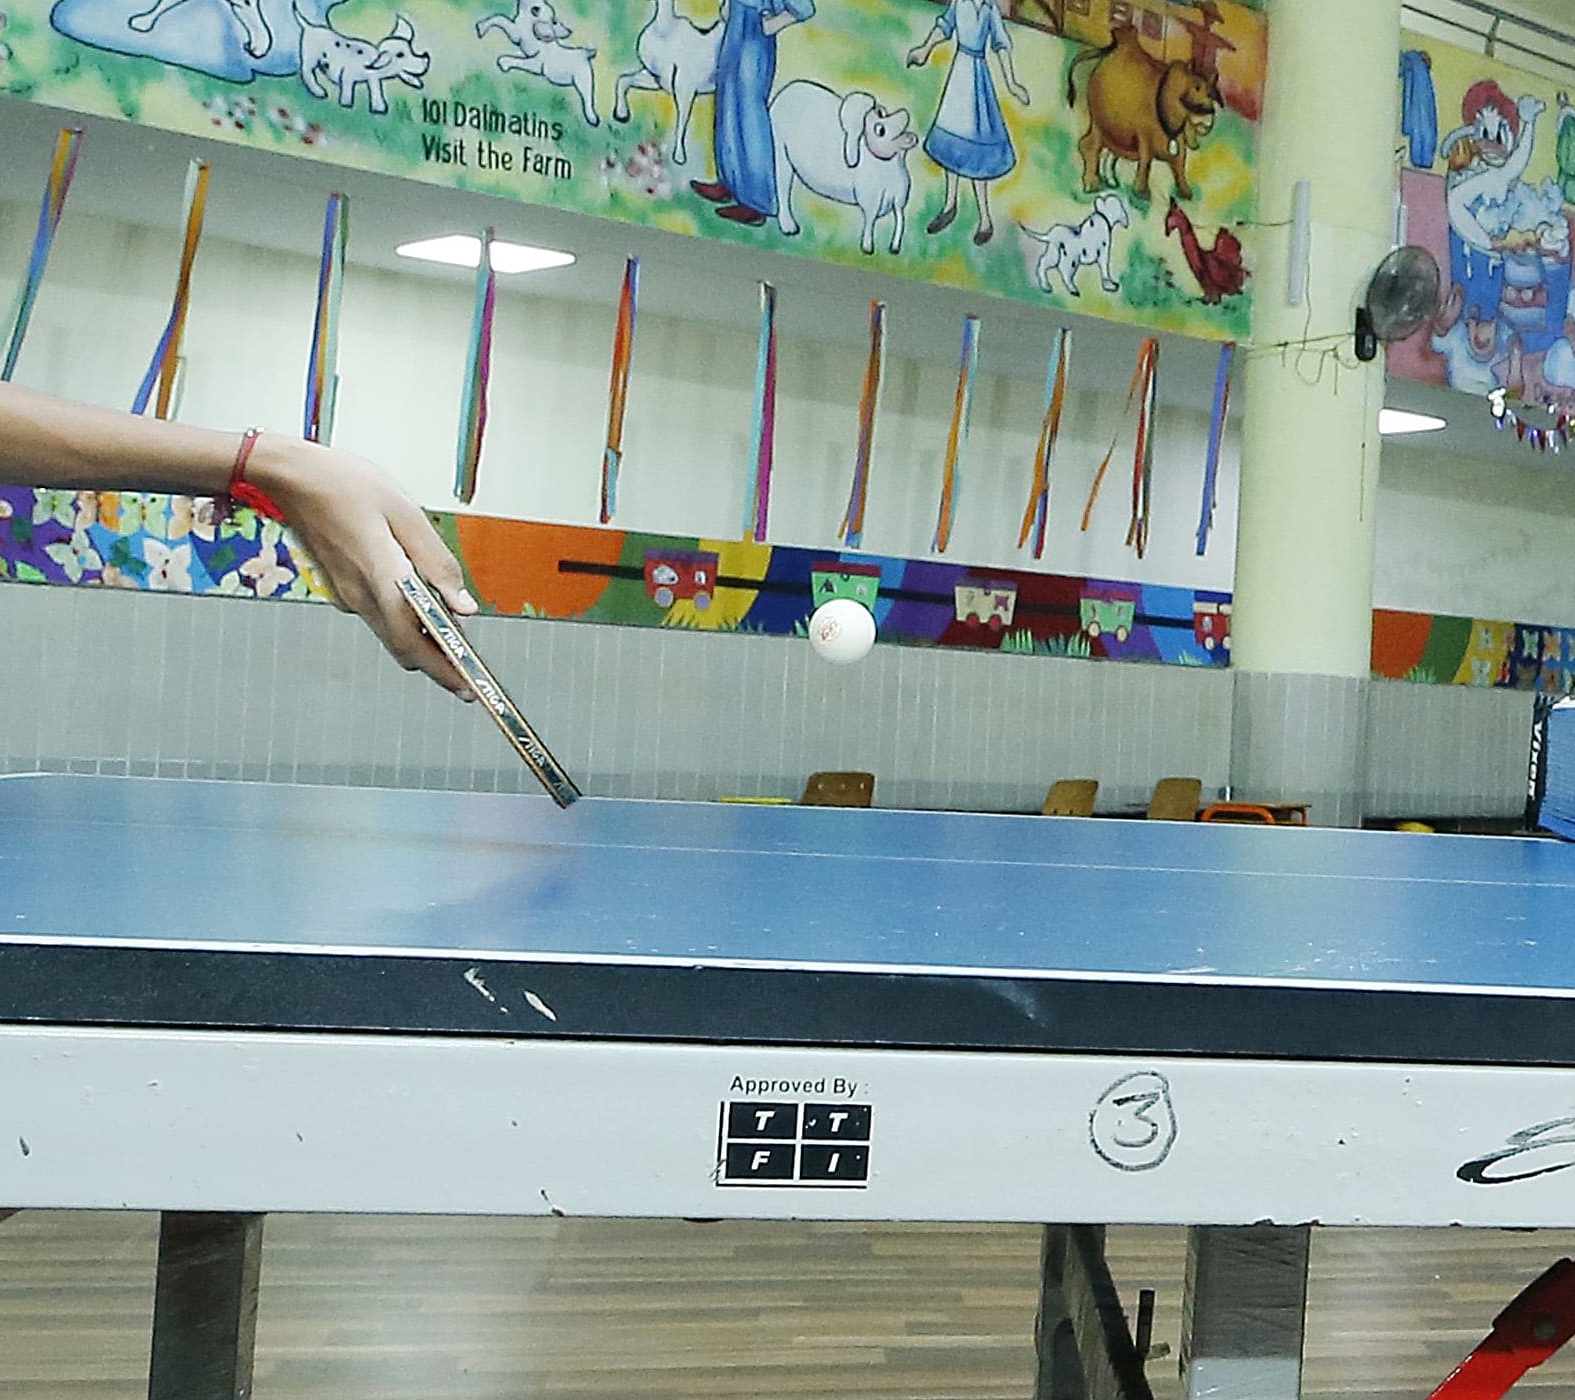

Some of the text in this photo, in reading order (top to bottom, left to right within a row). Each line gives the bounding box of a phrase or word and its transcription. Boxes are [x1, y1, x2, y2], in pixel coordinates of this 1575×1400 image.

[422, 98, 447, 124] 101
[422, 133, 571, 180] Visit the Farm
[730, 1075, 826, 1096] Approved
[833, 1078, 858, 1098] By
